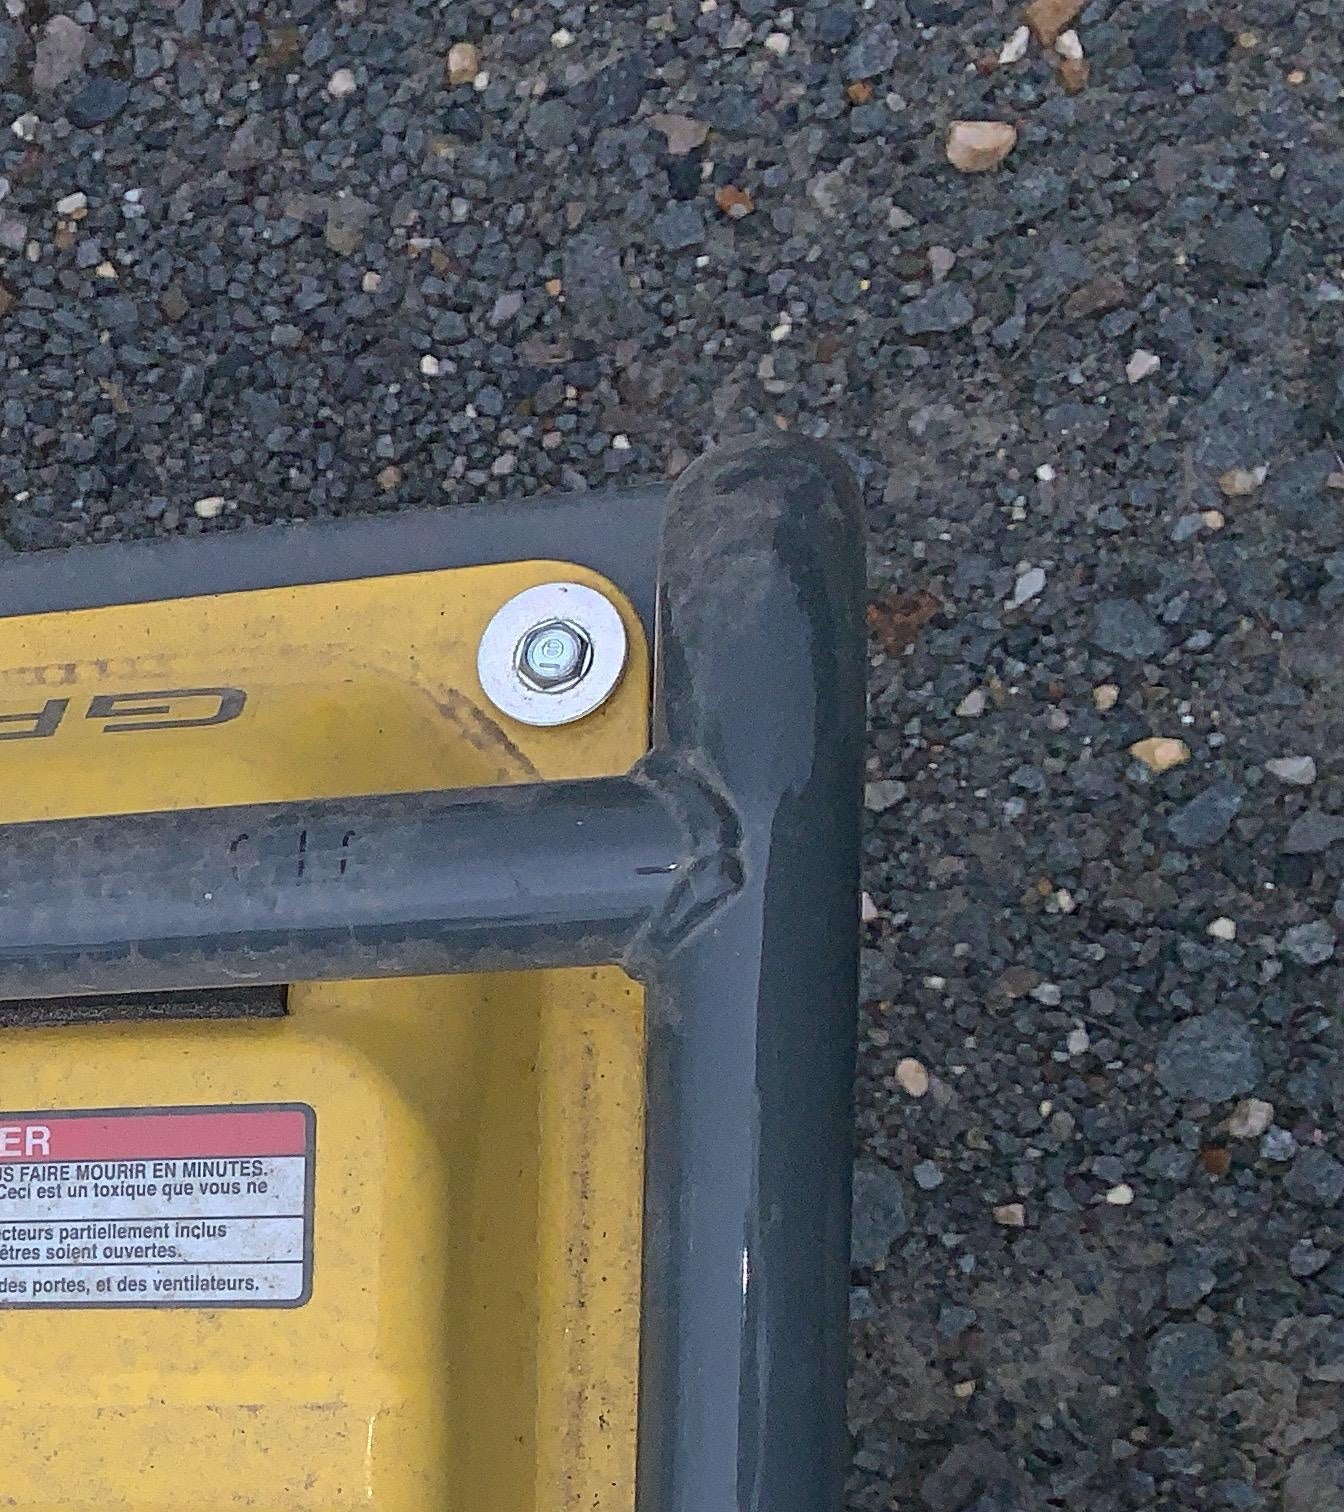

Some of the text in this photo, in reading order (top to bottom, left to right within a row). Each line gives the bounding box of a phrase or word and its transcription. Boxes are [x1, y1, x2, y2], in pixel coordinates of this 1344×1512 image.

[59, 1224, 169, 1244] partiellement
[175, 1223, 227, 1238] inclus
[32, 1278, 90, 1297] portes,
[96, 1278, 112, 1292] et
[117, 1277, 147, 1292] des
[153, 1276, 260, 1291] ventilateurs.
